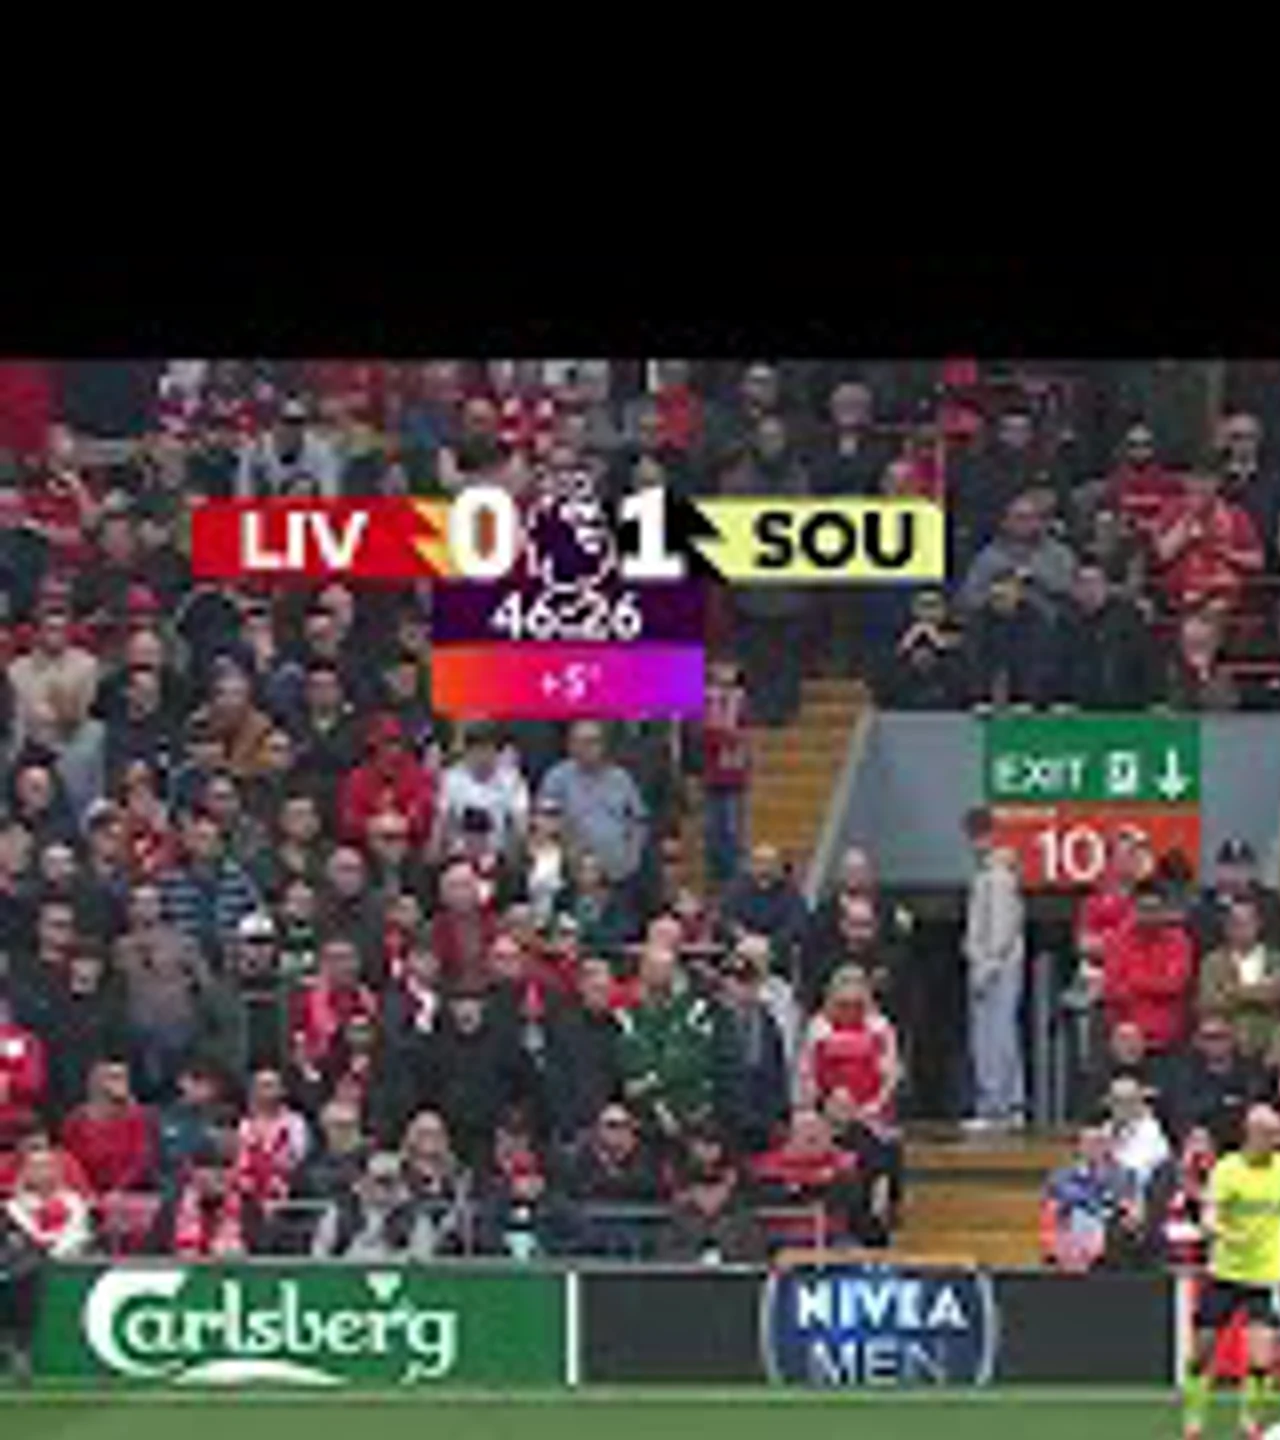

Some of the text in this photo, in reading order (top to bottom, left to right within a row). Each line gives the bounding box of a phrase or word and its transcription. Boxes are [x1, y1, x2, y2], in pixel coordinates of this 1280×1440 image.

[994, 752, 1084, 792] EXIT
[84, 1268, 457, 1383] Carlsberg
[797, 1282, 968, 1328] NIVEA
[812, 1338, 947, 1385] MEN
